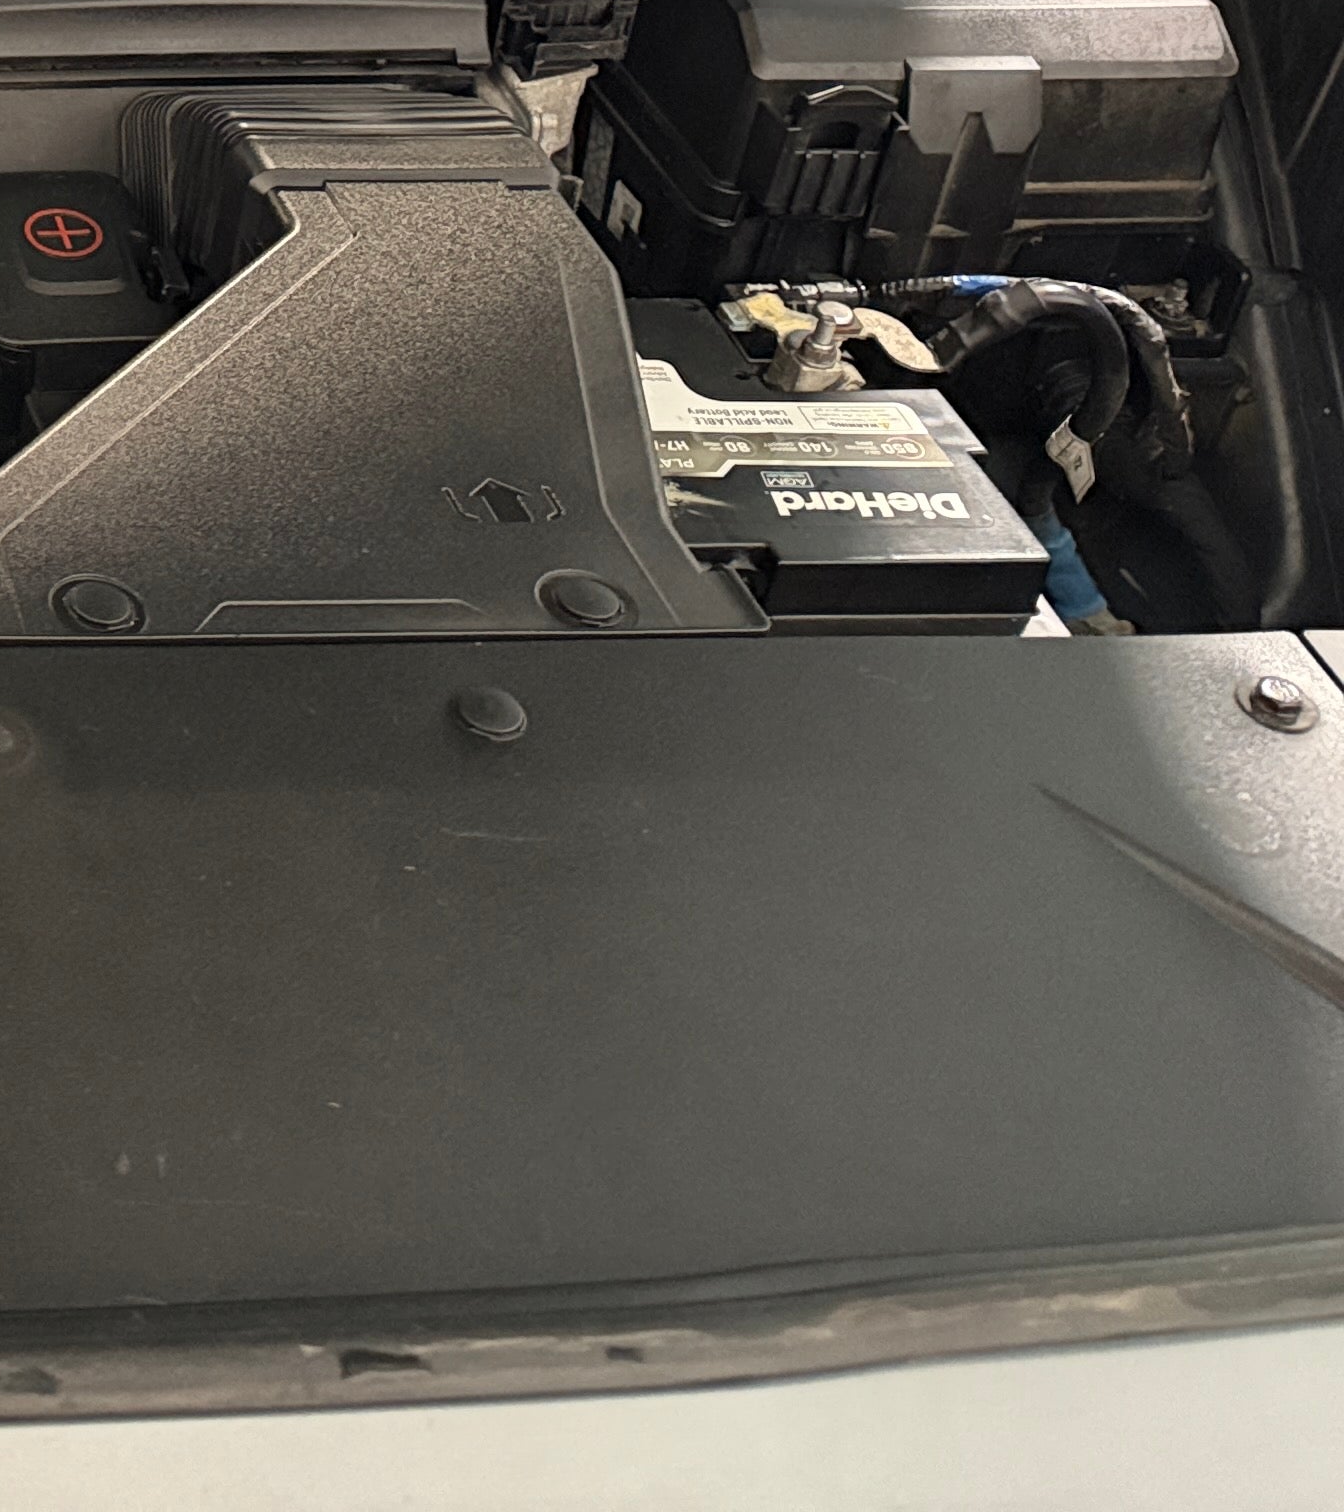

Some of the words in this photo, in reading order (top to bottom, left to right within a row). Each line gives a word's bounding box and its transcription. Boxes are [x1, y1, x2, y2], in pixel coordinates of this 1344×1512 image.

[732, 408, 756, 416] Acid
[694, 417, 794, 426] NON-SPILLABLE
[724, 441, 751, 453] 80
[799, 441, 832, 453] 140
[767, 477, 808, 487] AGM
[769, 491, 971, 519] DieHard
